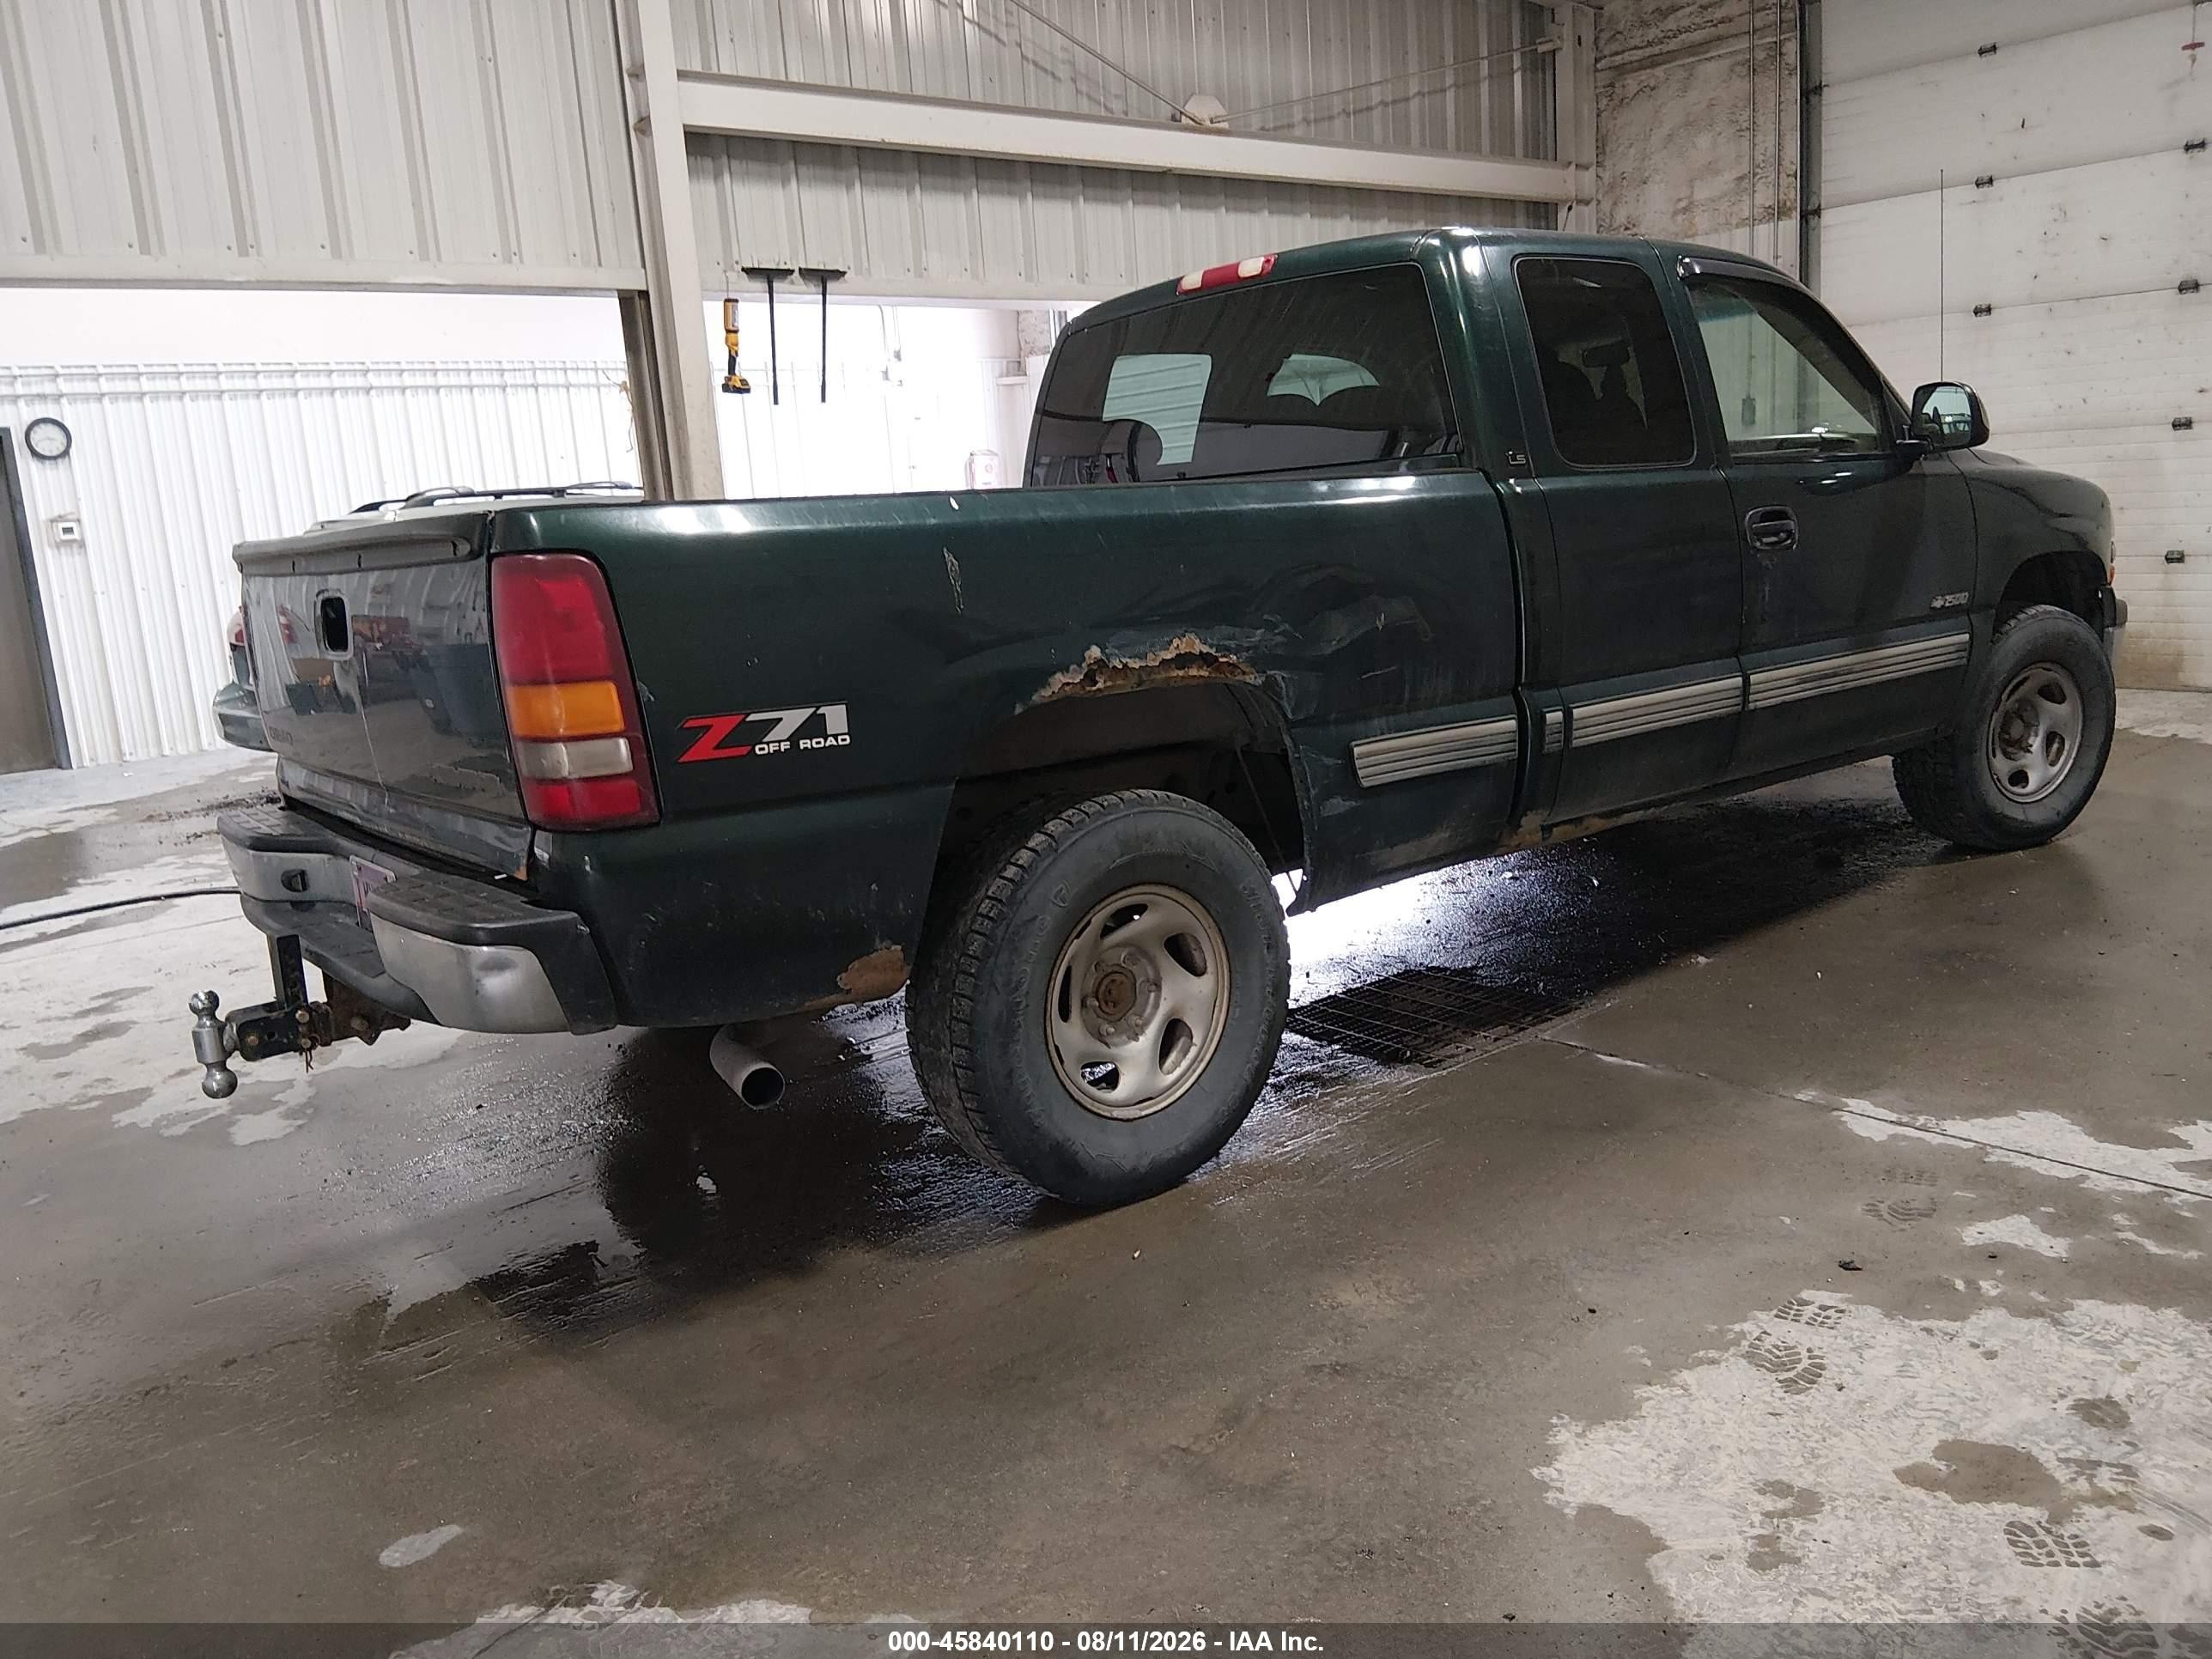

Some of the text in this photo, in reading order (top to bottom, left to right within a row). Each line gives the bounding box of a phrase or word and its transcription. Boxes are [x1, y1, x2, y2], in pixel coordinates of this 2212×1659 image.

[678, 704, 848, 763] Z71
[755, 734, 850, 755] OFF ROAD
